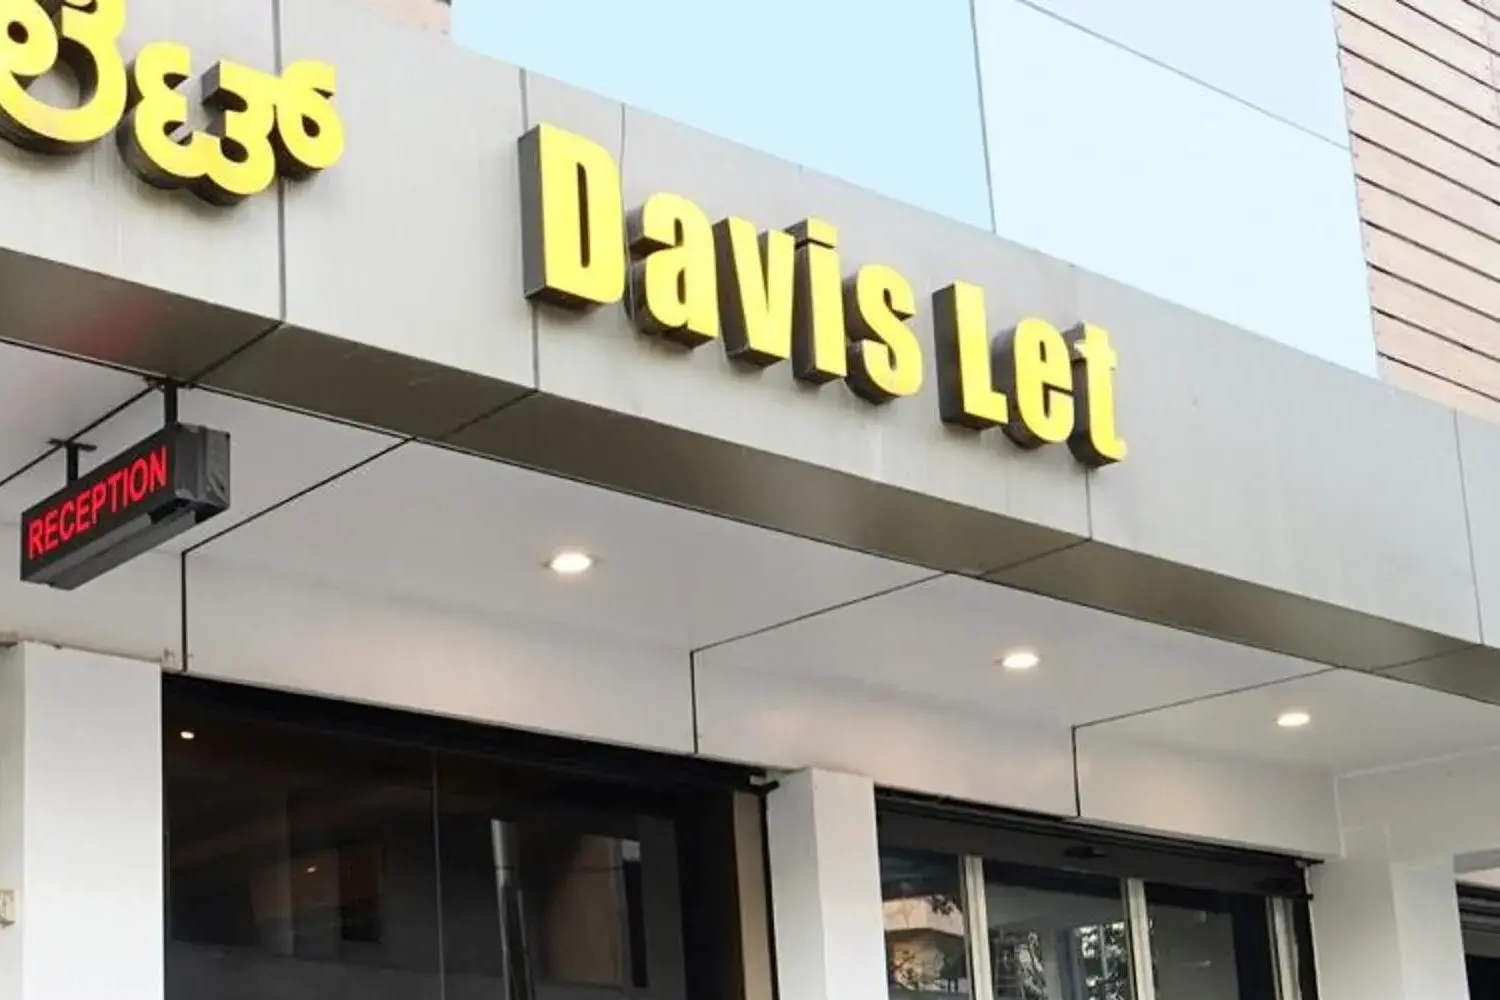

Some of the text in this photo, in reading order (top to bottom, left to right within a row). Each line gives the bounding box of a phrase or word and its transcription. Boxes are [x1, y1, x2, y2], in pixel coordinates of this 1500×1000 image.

[522, 124, 1128, 468] Davis Let
[28, 446, 168, 561] RECEPTION
